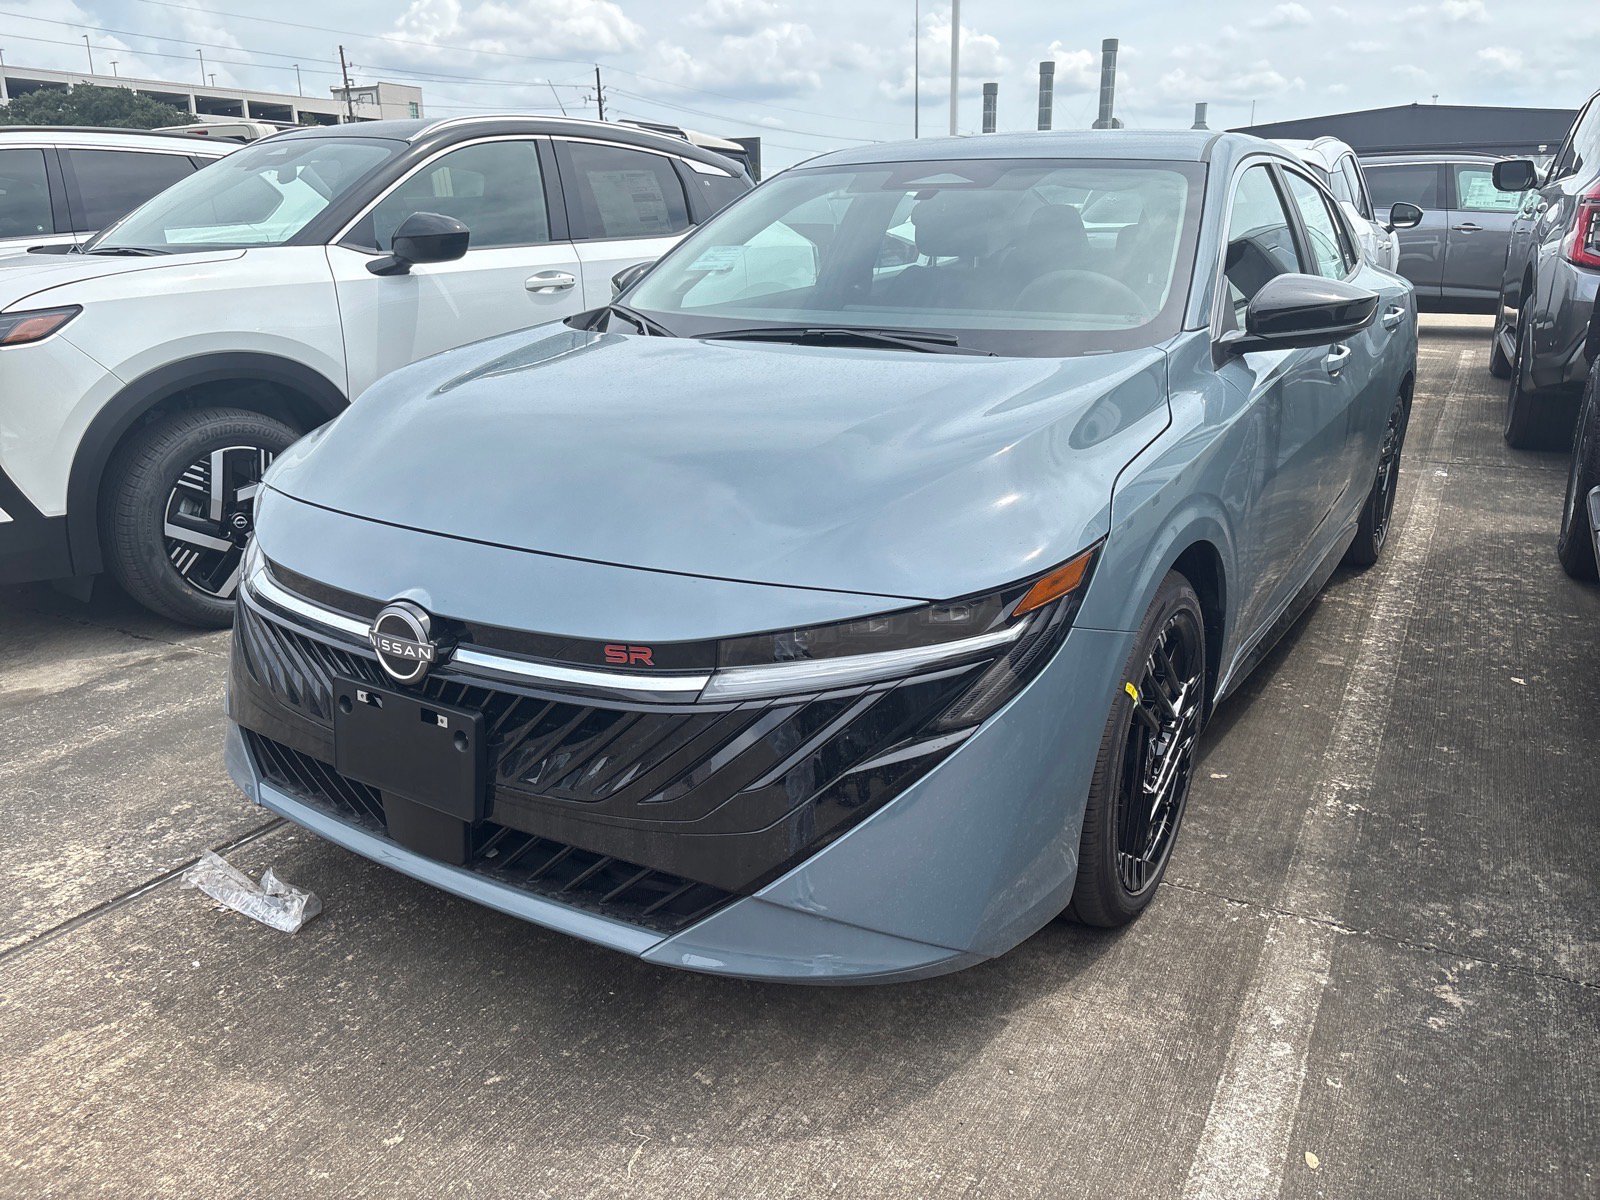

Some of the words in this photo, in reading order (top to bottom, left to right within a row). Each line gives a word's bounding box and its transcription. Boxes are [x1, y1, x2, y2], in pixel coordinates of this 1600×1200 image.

[198, 423, 287, 443] BRIDGESTONE
[369, 635, 431, 660] NISSAN
[604, 645, 655, 665] SR
